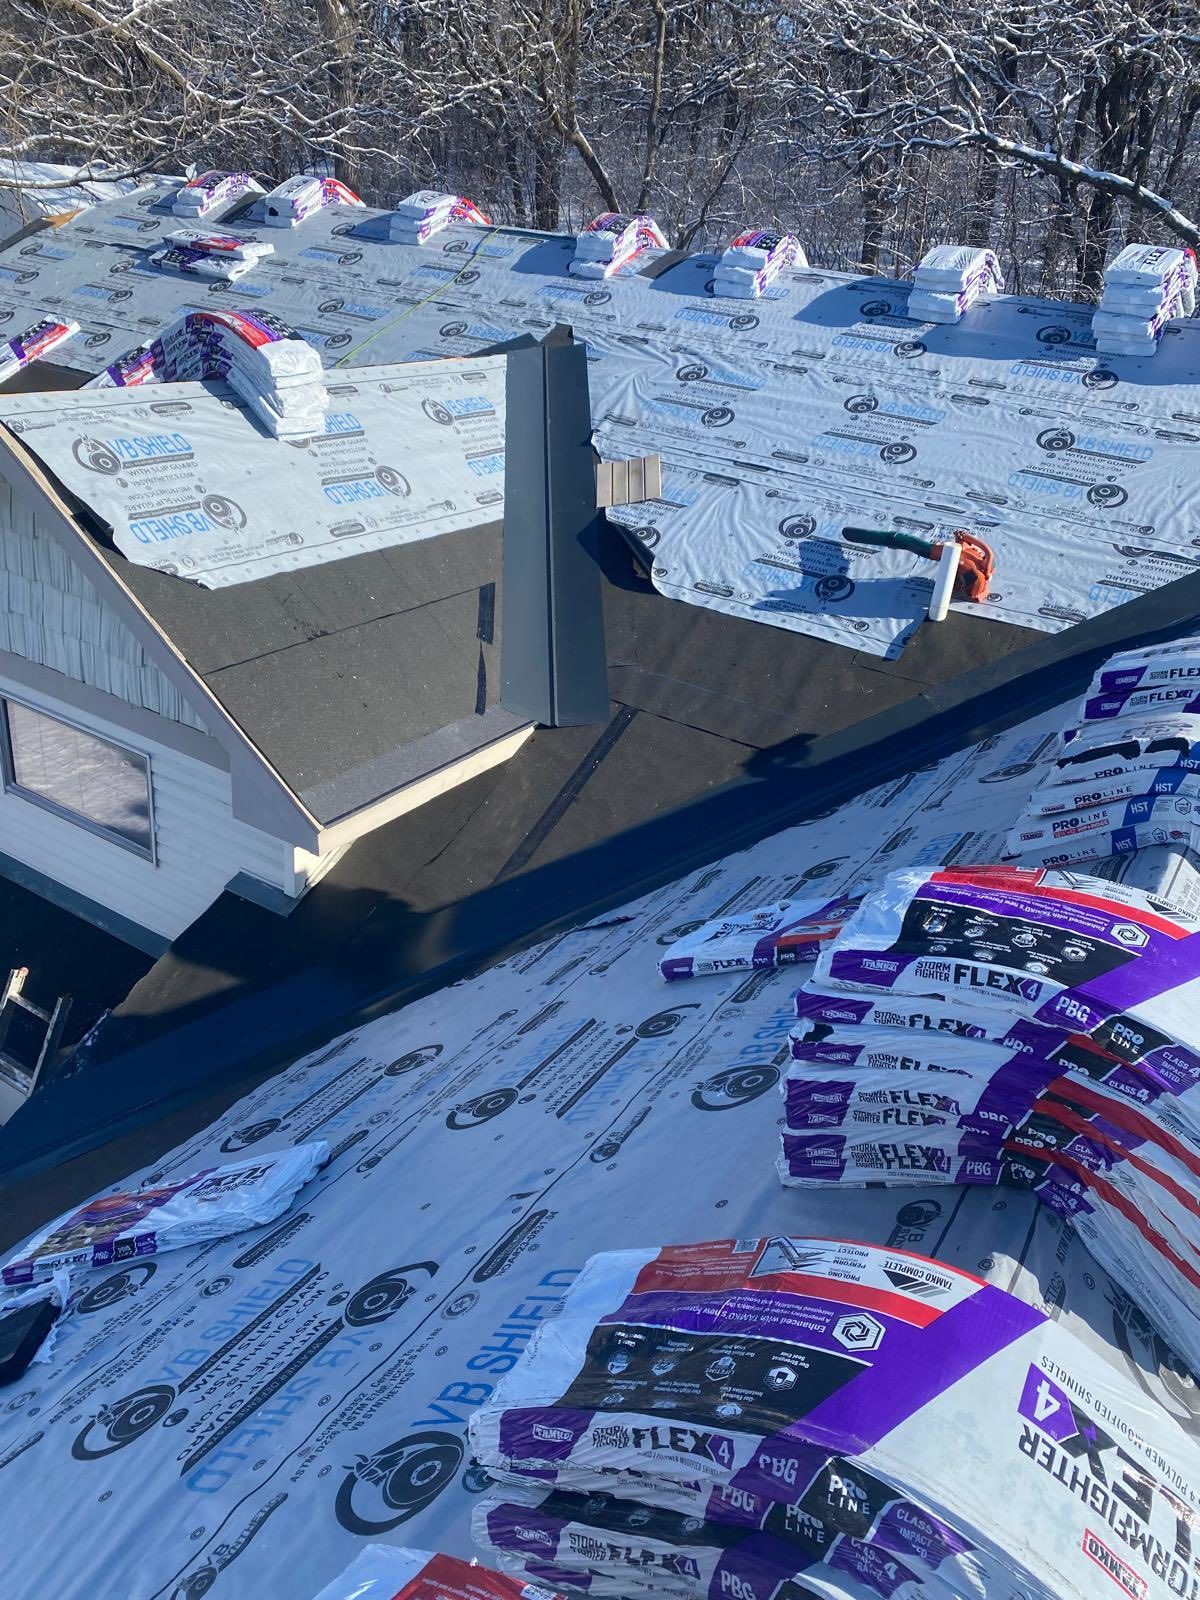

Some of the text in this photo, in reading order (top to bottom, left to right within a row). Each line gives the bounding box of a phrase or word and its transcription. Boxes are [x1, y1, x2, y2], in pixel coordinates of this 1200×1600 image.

[1010, 364, 1056, 380] SHIELD
[138, 433, 192, 457] SHIELD
[129, 516, 186, 544] SHIELD
[1074, 792, 1102, 804] PRO
[1103, 785, 1133, 798] LINE
[1155, 783, 1173, 792] HST
[1131, 802, 1148, 813] HST
[1052, 810, 1108, 832] PRO LINE
[1116, 838, 1132, 851] HST
[1042, 854, 1069, 866] PRO
[1070, 848, 1097, 858] LINE
[915, 968, 950, 982] FIGHTER
[917, 960, 950, 972] STORM
[953, 964, 1022, 995] FLEX
[1056, 996, 1090, 1024] PBG
[1111, 1032, 1143, 1054] LINE
[1113, 1022, 1145, 1045] PRO
[1161, 1061, 1185, 1078] IMPACT
[1162, 1051, 1189, 1070] CLASS
[1160, 1069, 1181, 1083] RATED
[1109, 1080, 1150, 1103] CLASS 4
[1156, 1115, 1183, 1136] PROTECT
[966, 1161, 992, 1176] PBG
[884, 1261, 953, 1291] TAMKO COMPLETE
[147, 1258, 315, 1385] VB SHIELD
[188, 1271, 330, 1393] WITH SLIP GUARD
[779, 1317, 826, 1333] Enhanced
[1041, 1355, 1092, 1403] SHINGLES
[409, 1381, 494, 1428] VB
[1033, 1379, 1061, 1422] 4
[187, 1375, 321, 1494] SHIELD
[592, 1425, 629, 1439] STORM
[632, 1426, 730, 1462] FLEX 4
[288, 1452, 319, 1483] ASTM
[759, 1454, 799, 1485] PBG
[829, 1475, 867, 1500] PRO
[720, 1487, 757, 1512] PBG
[827, 1494, 870, 1515] LINE
[786, 1504, 824, 1529] PRO
[897, 1508, 933, 1534] CLASS
[785, 1519, 825, 1543] LINE
[198, 1543, 230, 1568] VB
[685, 1559, 694, 1574] 4
[720, 1569, 757, 1600] PBG
